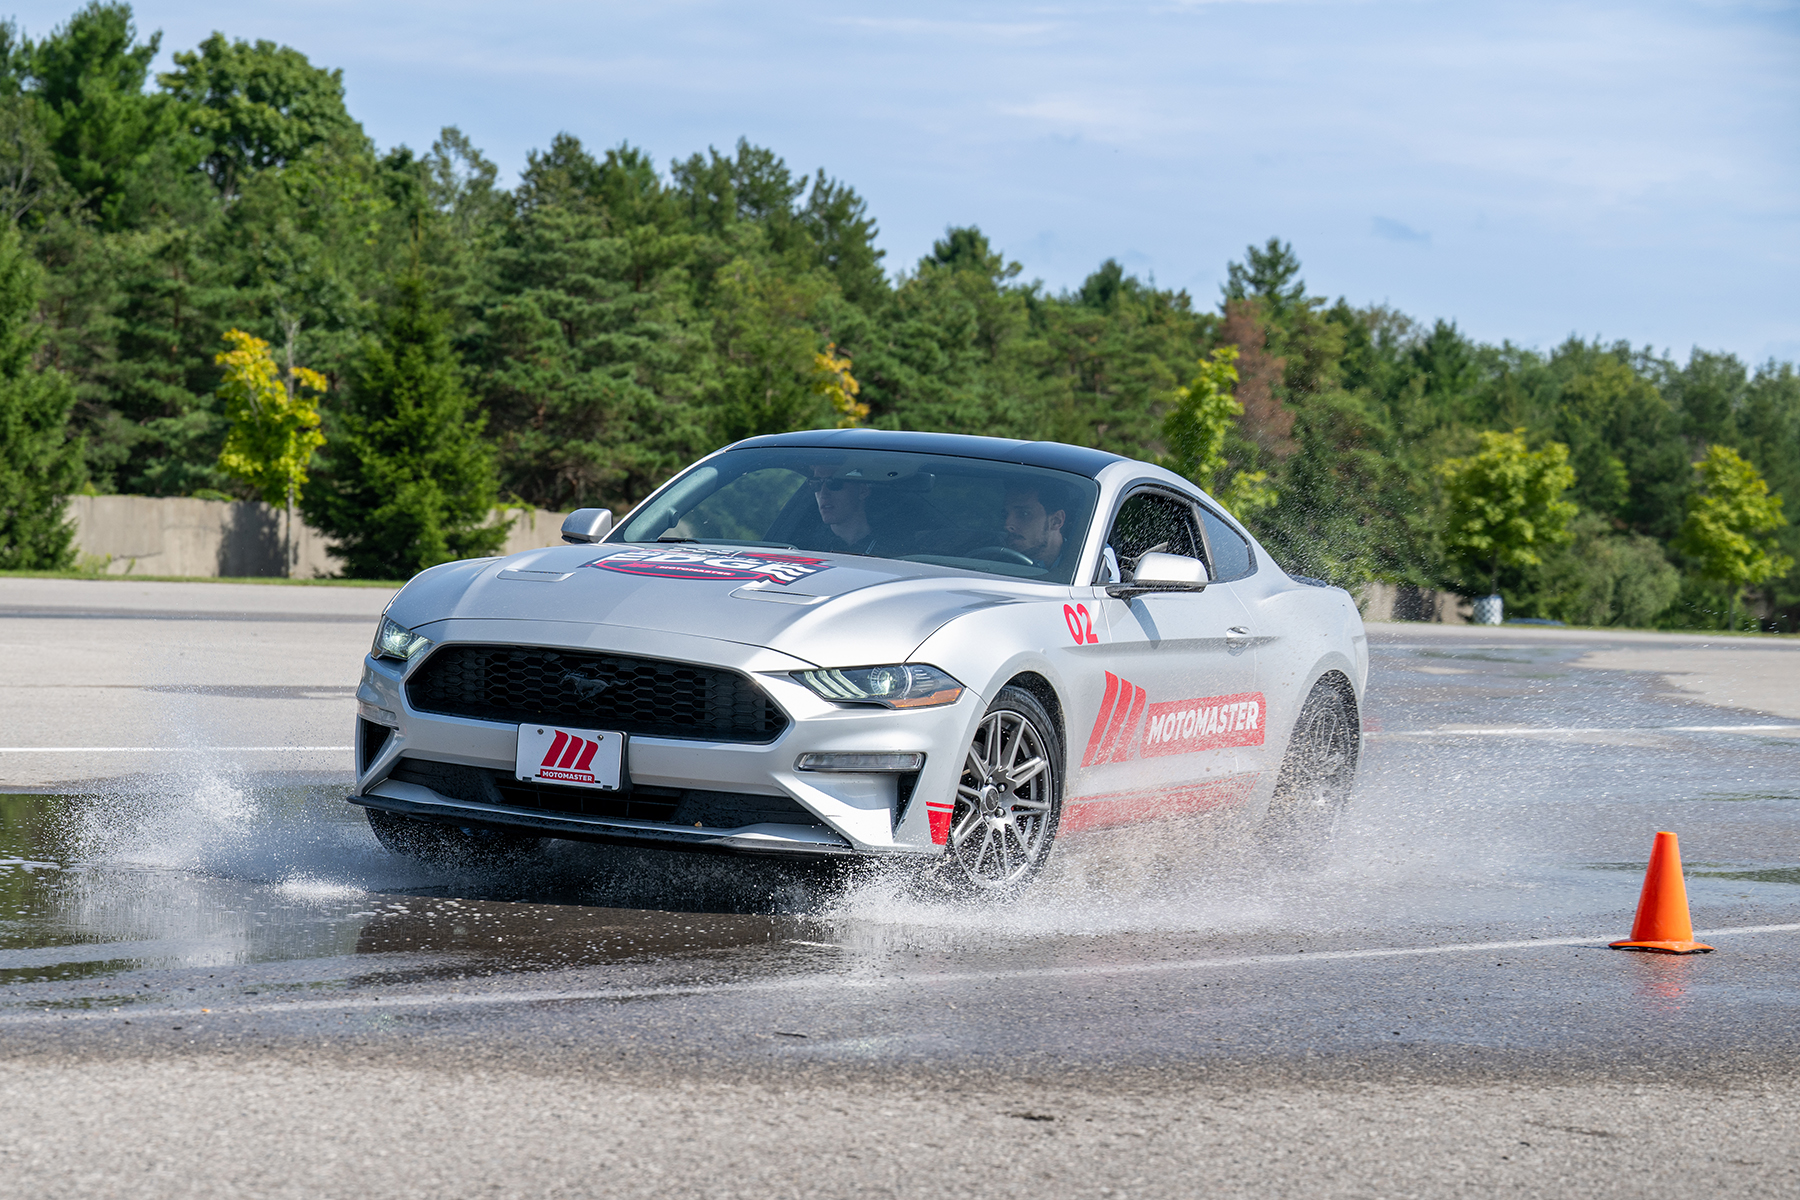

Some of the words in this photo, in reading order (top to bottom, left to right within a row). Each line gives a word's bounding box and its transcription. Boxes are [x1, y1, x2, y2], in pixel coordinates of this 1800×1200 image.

[592, 552, 817, 582] EDGE
[1063, 603, 1099, 646] 02
[1147, 701, 1260, 745] MOTOMASTER
[542, 770, 593, 782] MOTOMASTER
